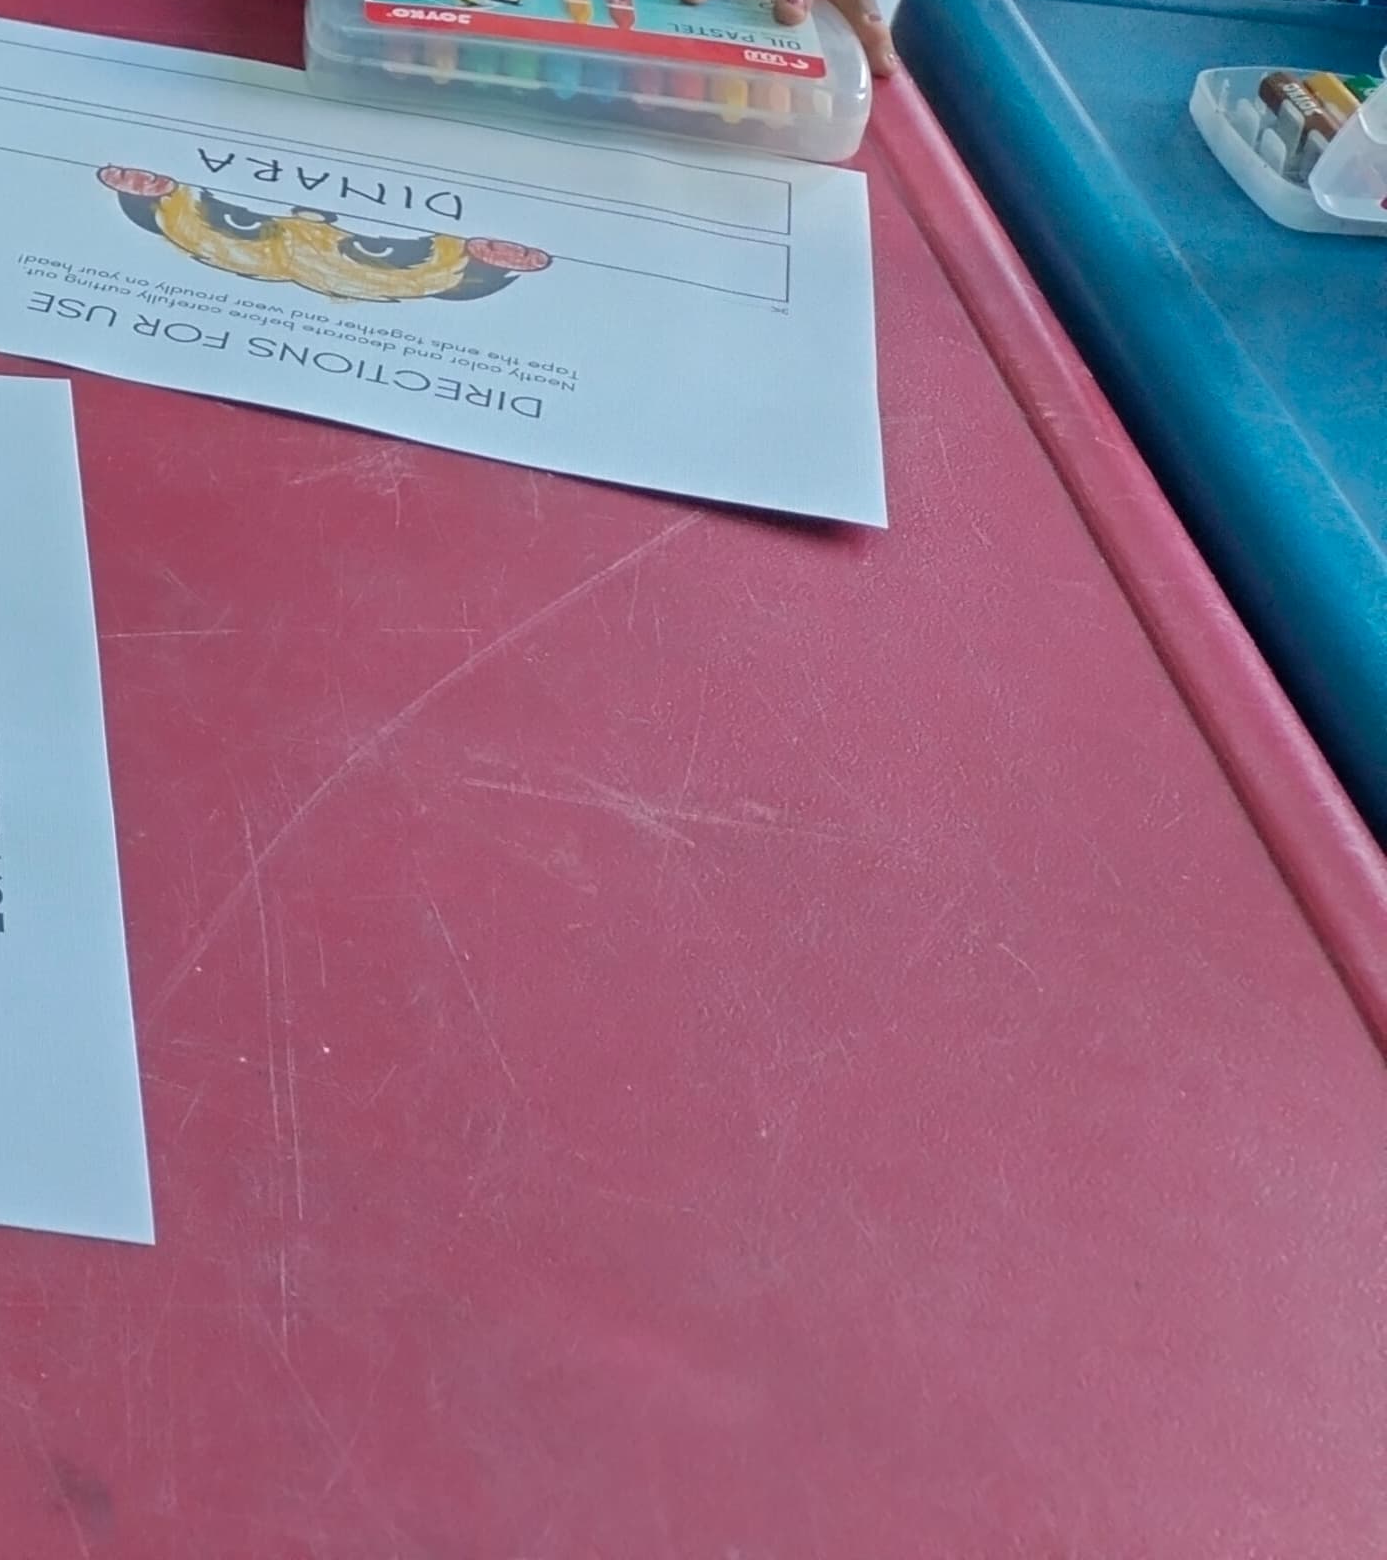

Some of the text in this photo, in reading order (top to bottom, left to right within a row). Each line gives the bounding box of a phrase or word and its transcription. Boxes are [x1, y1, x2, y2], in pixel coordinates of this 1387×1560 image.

[392, 7, 472, 24] JOYKO
[667, 23, 802, 50] OIL PASTEL
[196, 148, 463, 221] DINARA
[17, 253, 578, 380] Tape the ends together and wear proudly on your head!
[23, 267, 575, 391] Neatly color and decorate before carefully cutting out.
[27, 291, 542, 418] DIRECTIONS FOR USE
